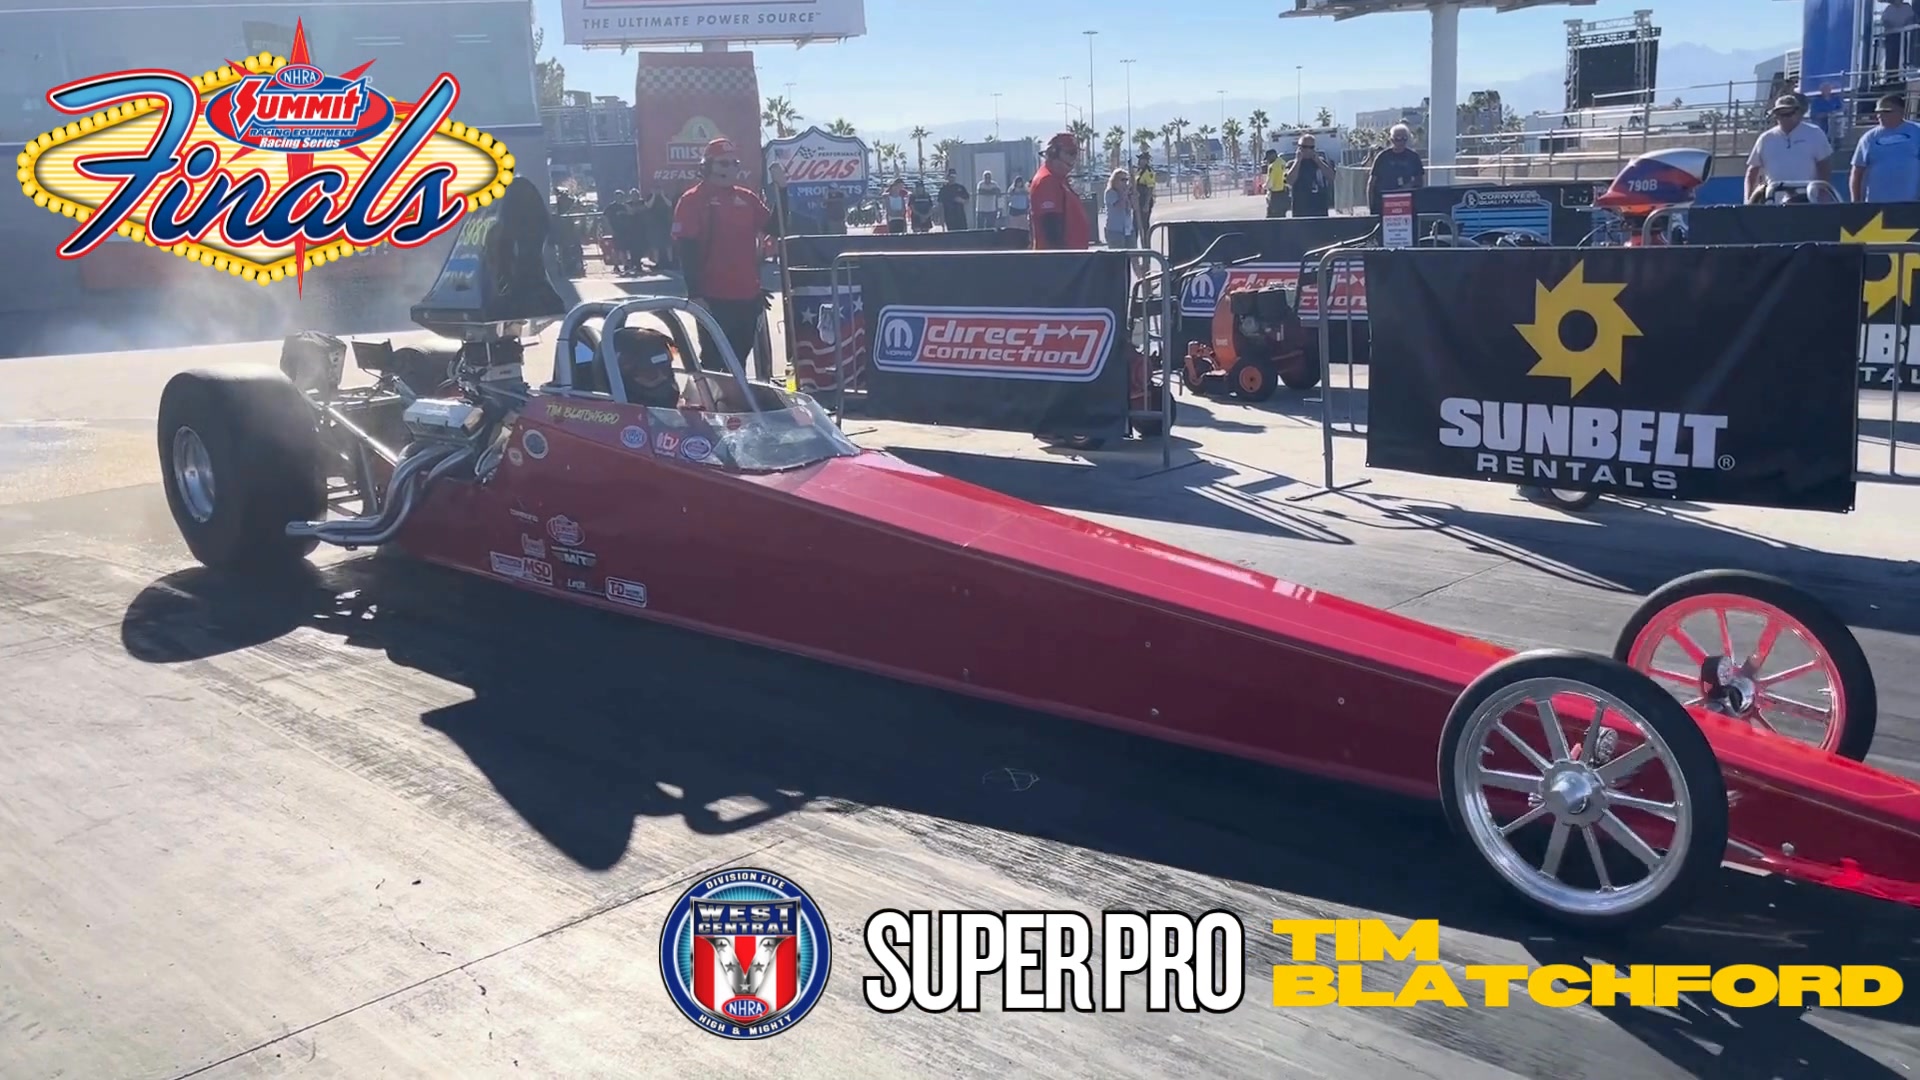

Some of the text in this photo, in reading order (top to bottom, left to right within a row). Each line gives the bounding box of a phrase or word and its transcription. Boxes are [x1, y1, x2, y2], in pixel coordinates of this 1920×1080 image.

[583, 19, 609, 29] THE
[618, 16, 689, 29] ULTIMATE
[696, 14, 750, 26] POWER
[1627, 179, 1658, 192] 790B
[927, 320, 1048, 346] direct
[923, 345, 1088, 365] connection
[1439, 397, 1728, 469] SUNBELT
[1477, 456, 1678, 490] RENTALS
[524, 558, 551, 577] MSD
